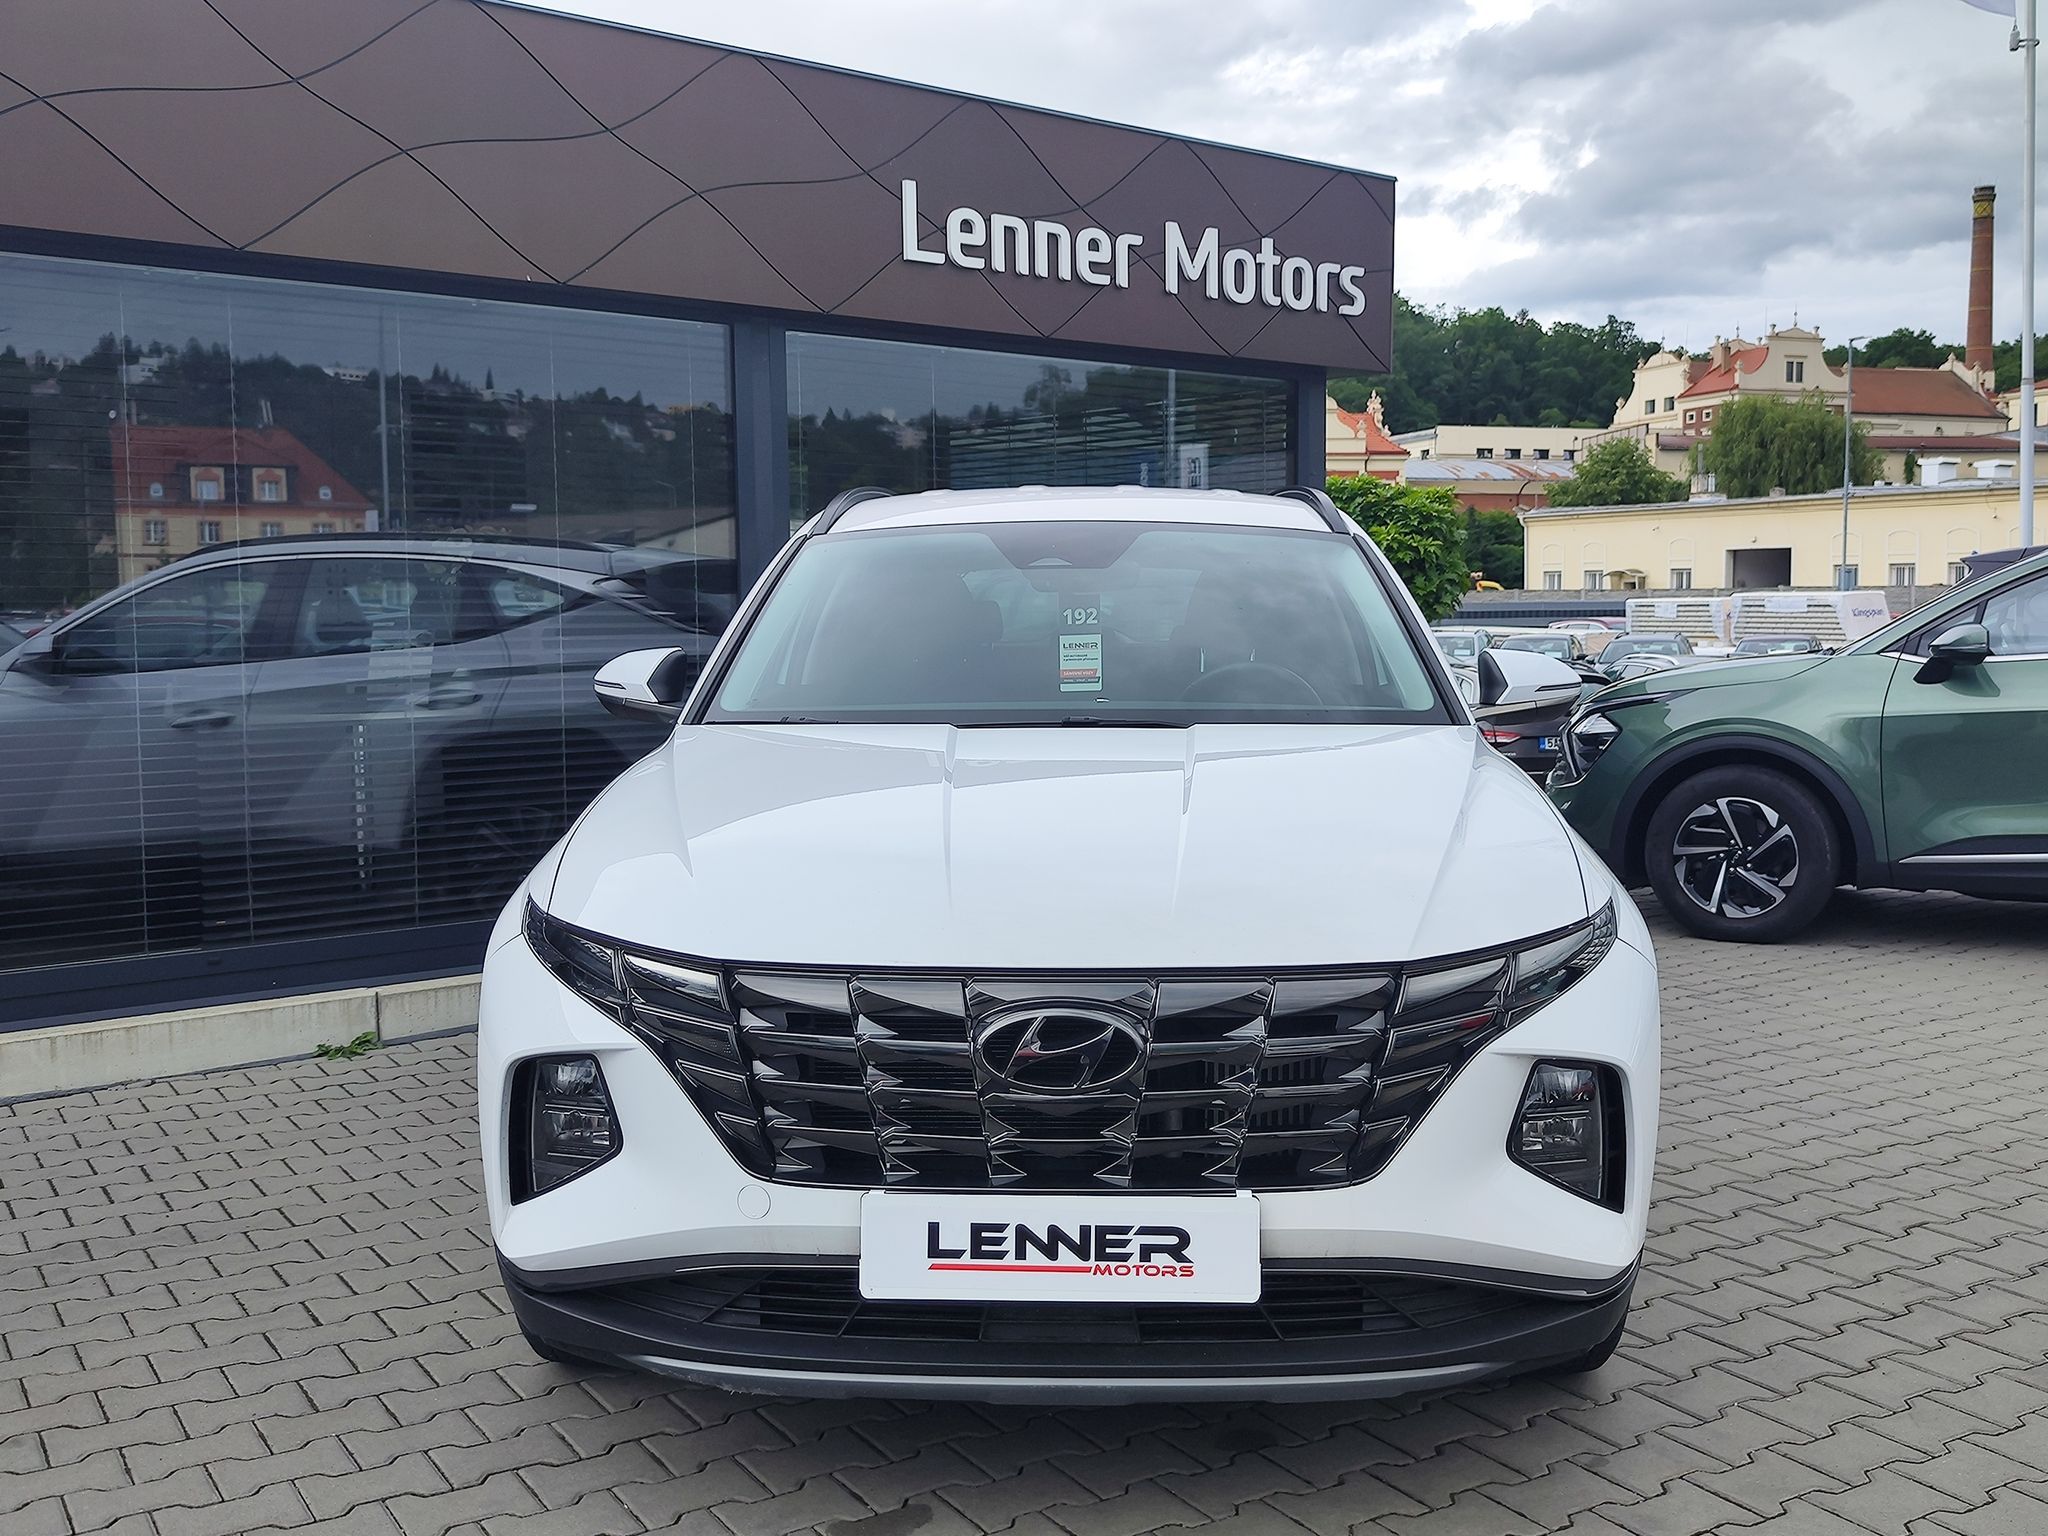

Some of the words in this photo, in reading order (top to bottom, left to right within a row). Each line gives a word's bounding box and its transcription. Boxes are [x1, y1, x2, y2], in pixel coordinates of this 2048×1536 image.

[901, 178, 1144, 289] Lenner
[1164, 220, 1367, 317] Motors
[1063, 607, 1098, 625] 192
[927, 1221, 1195, 1263] LENNER
[1092, 1263, 1195, 1278] MOTORS
